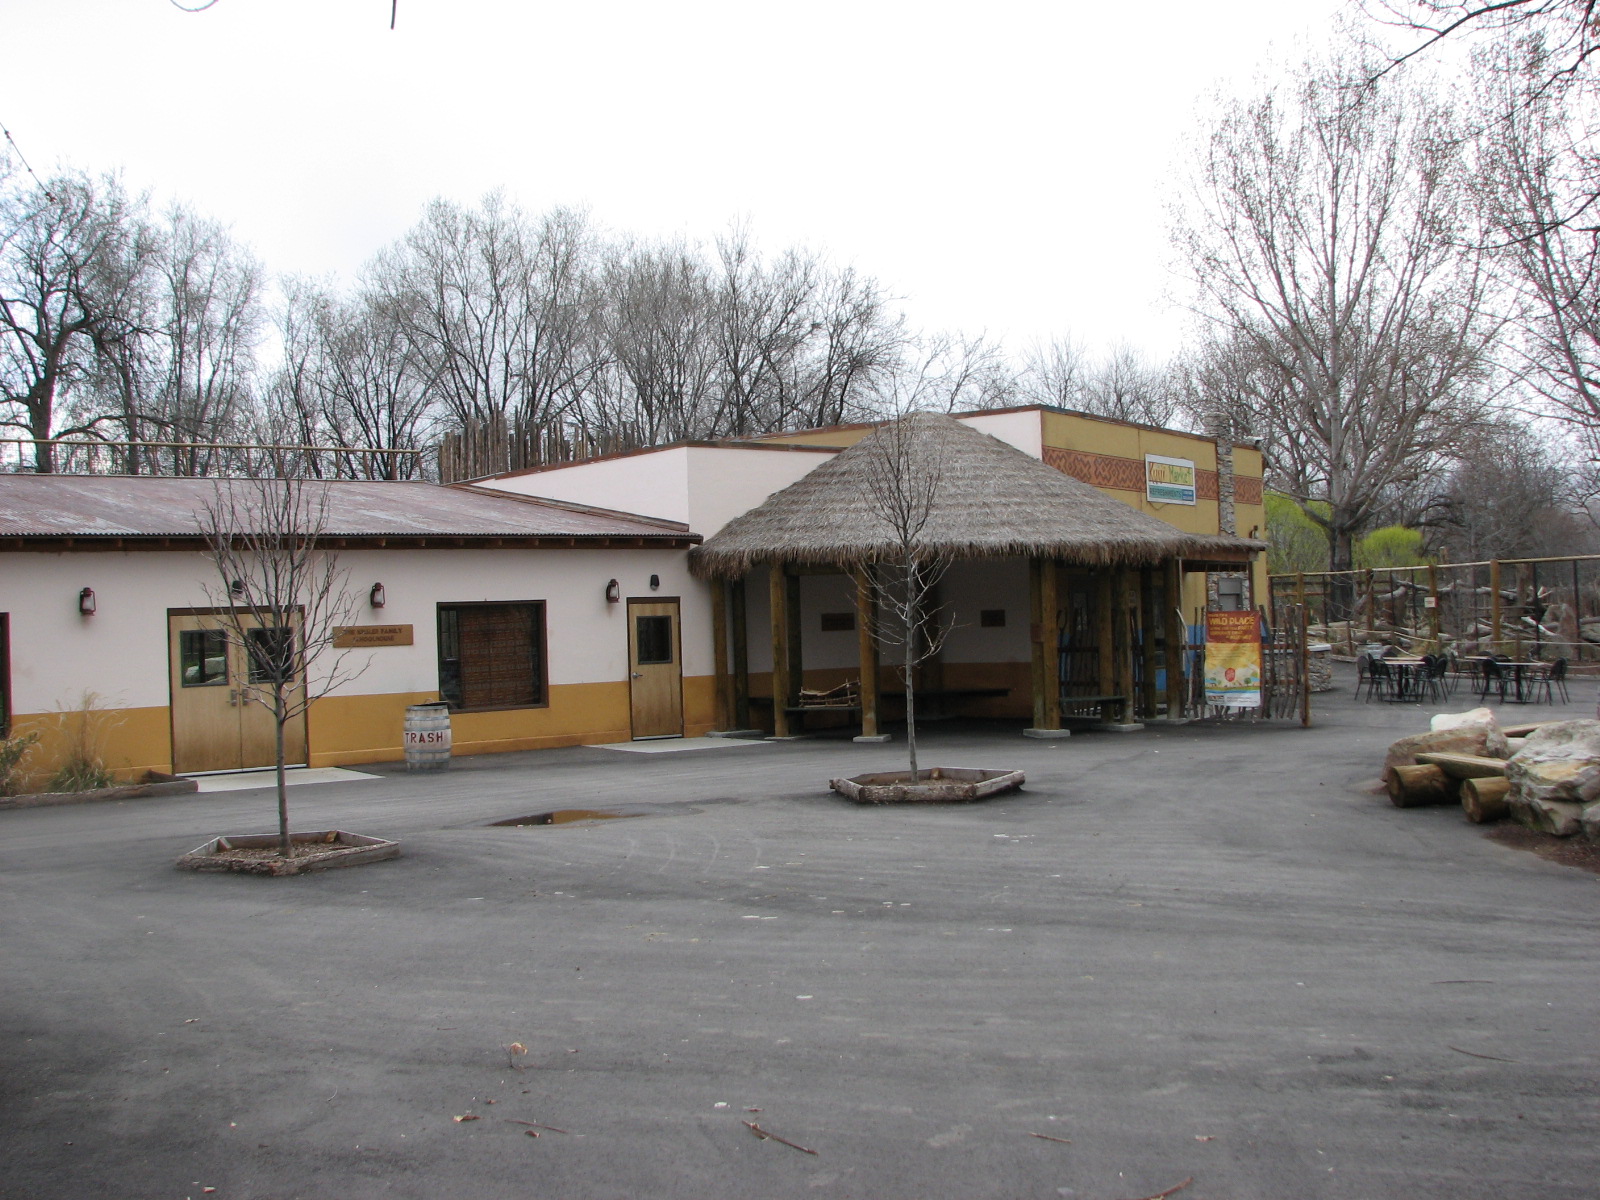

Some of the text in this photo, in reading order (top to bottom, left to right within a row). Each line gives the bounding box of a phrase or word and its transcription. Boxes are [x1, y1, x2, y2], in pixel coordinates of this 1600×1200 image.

[1209, 616, 1255, 625] WILD PLACE
[405, 731, 443, 743] TRASH
